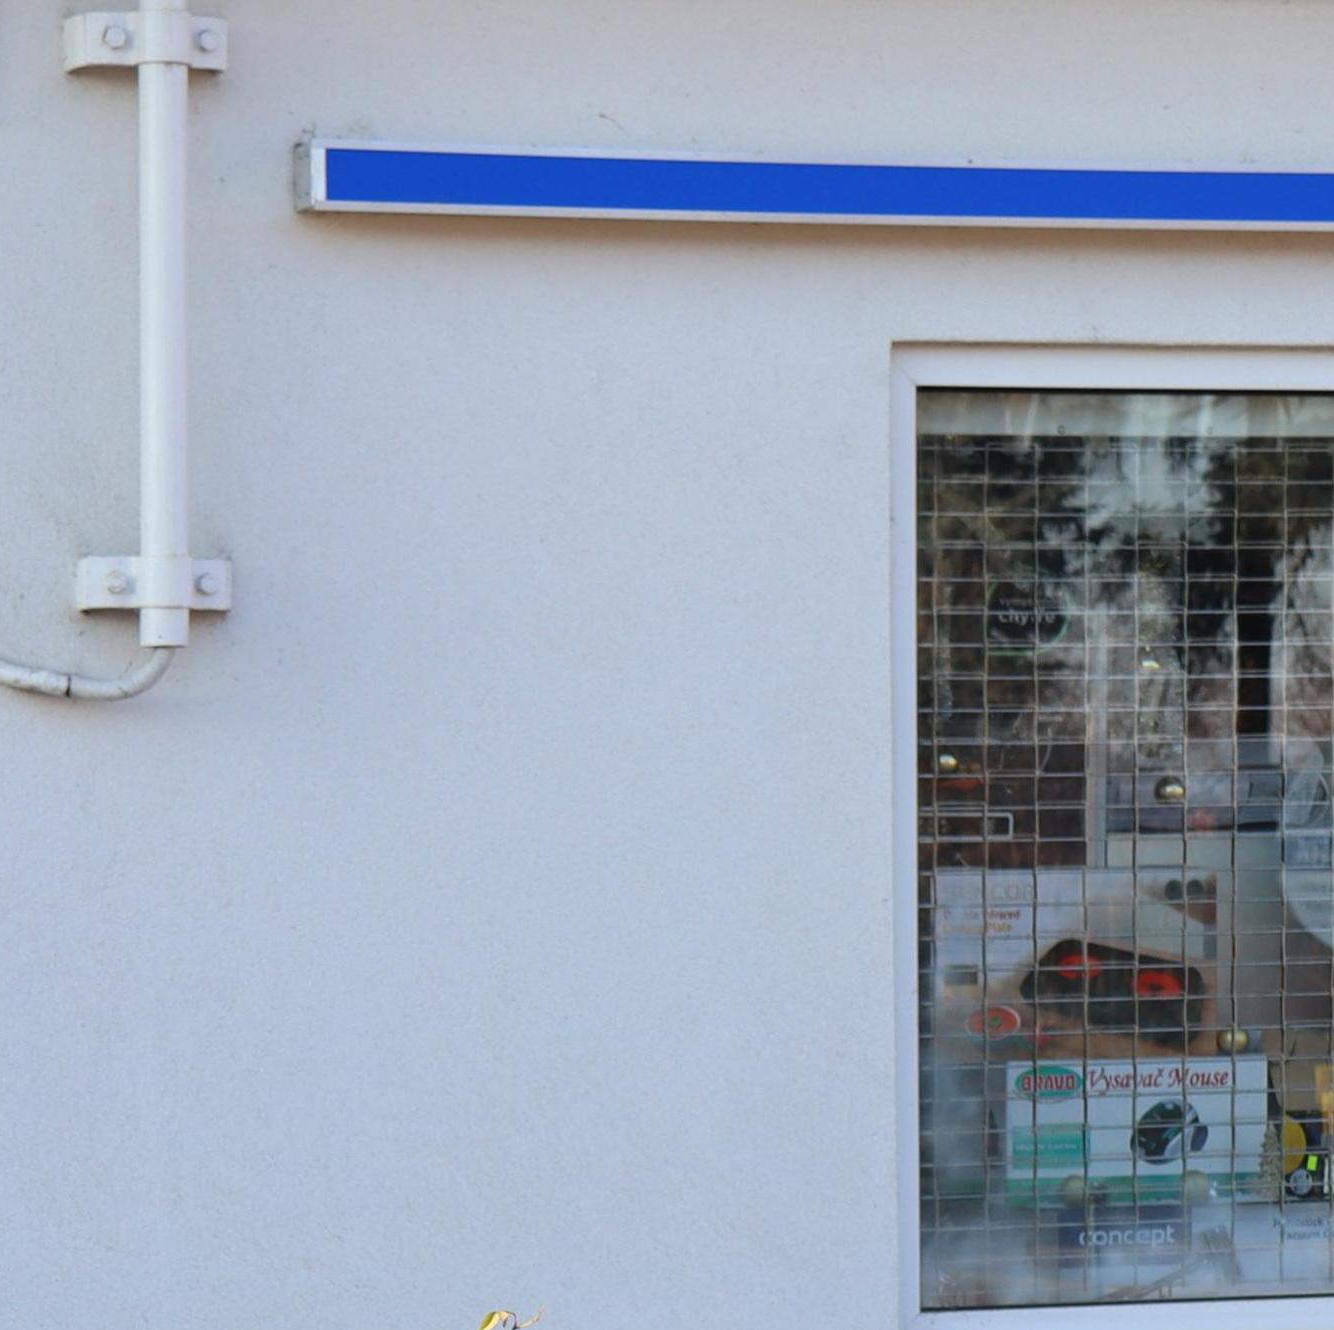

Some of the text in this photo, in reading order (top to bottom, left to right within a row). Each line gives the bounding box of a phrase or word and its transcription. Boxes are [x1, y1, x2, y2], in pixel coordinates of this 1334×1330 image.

[1022, 1074, 1075, 1091] BRAVO
[1168, 1067, 1229, 1088] Mouse
[1079, 1224, 1176, 1248] concept
